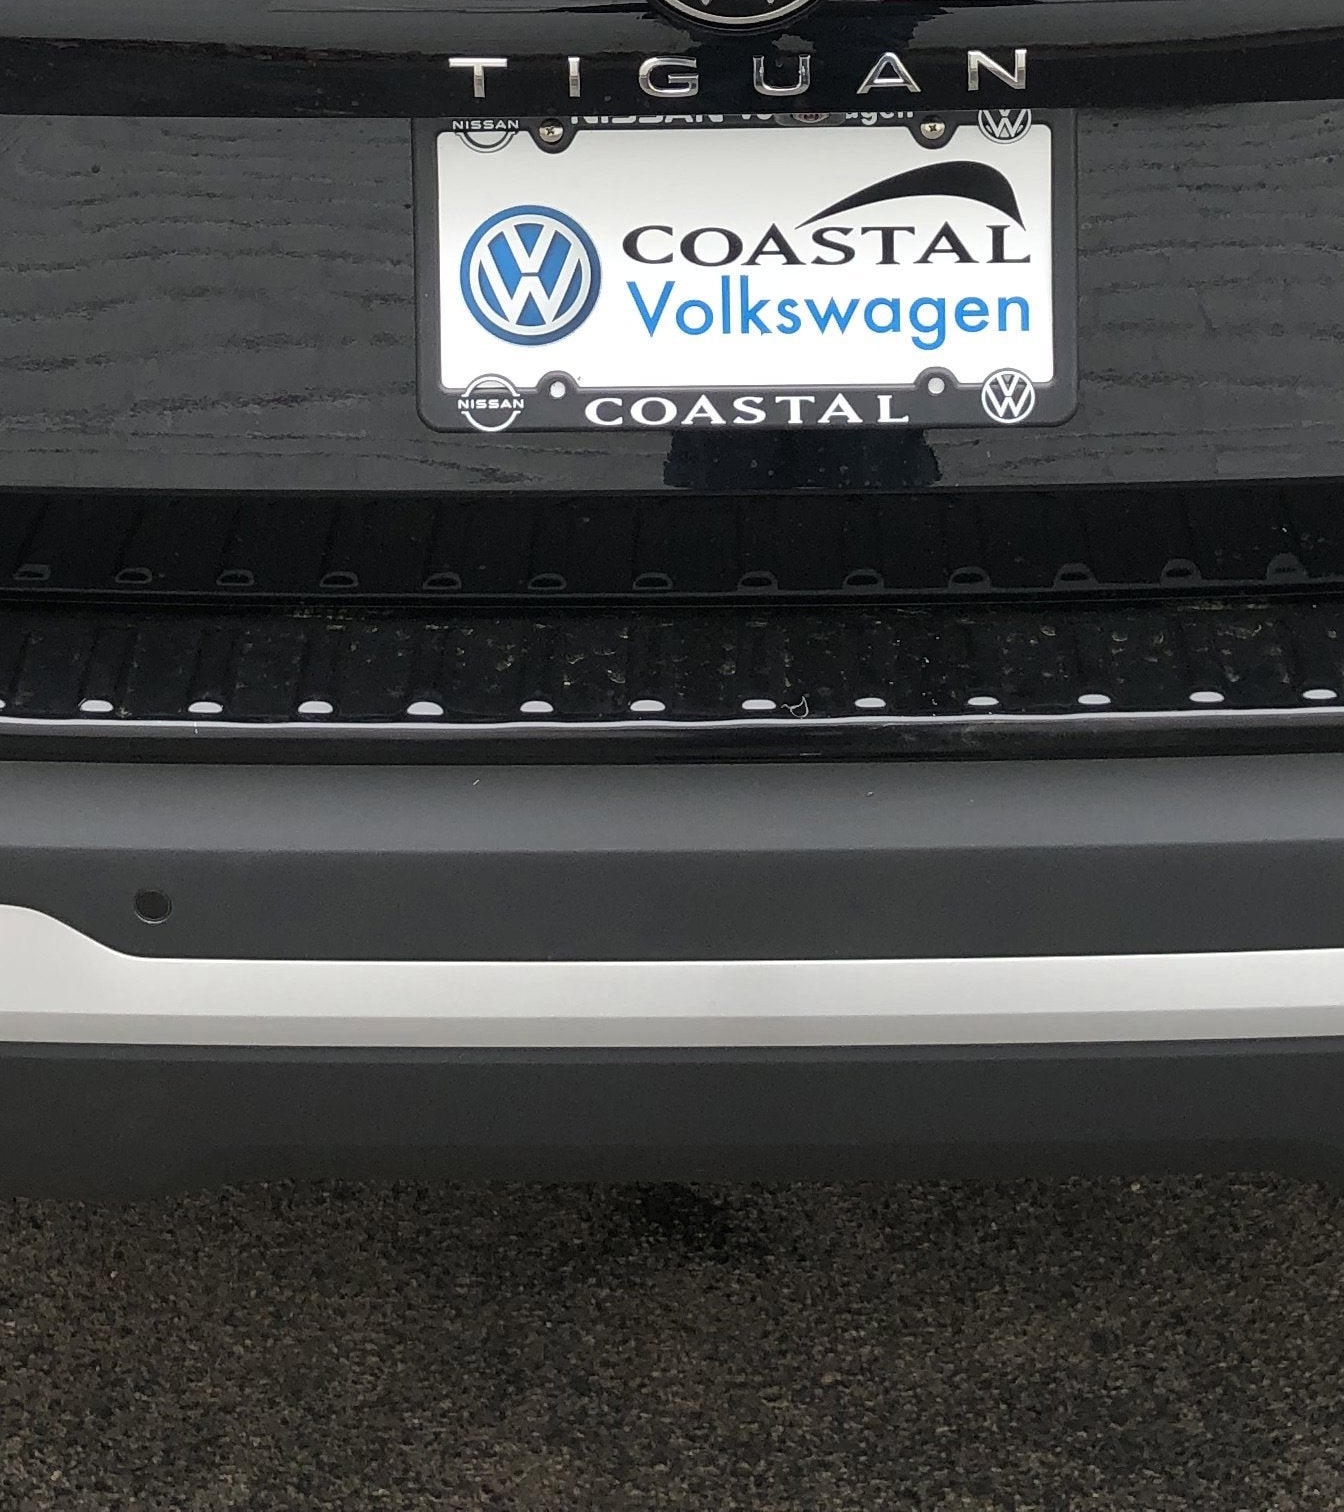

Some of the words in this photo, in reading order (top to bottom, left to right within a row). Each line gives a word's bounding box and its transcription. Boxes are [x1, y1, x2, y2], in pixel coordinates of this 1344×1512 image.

[448, 48, 1028, 98] TIGUAN
[452, 119, 519, 130] NISSAN
[622, 221, 1031, 267] COASTAL
[626, 274, 1030, 350] Volkswagen
[458, 399, 524, 409] NISSAN
[585, 393, 909, 425] COASTAL
